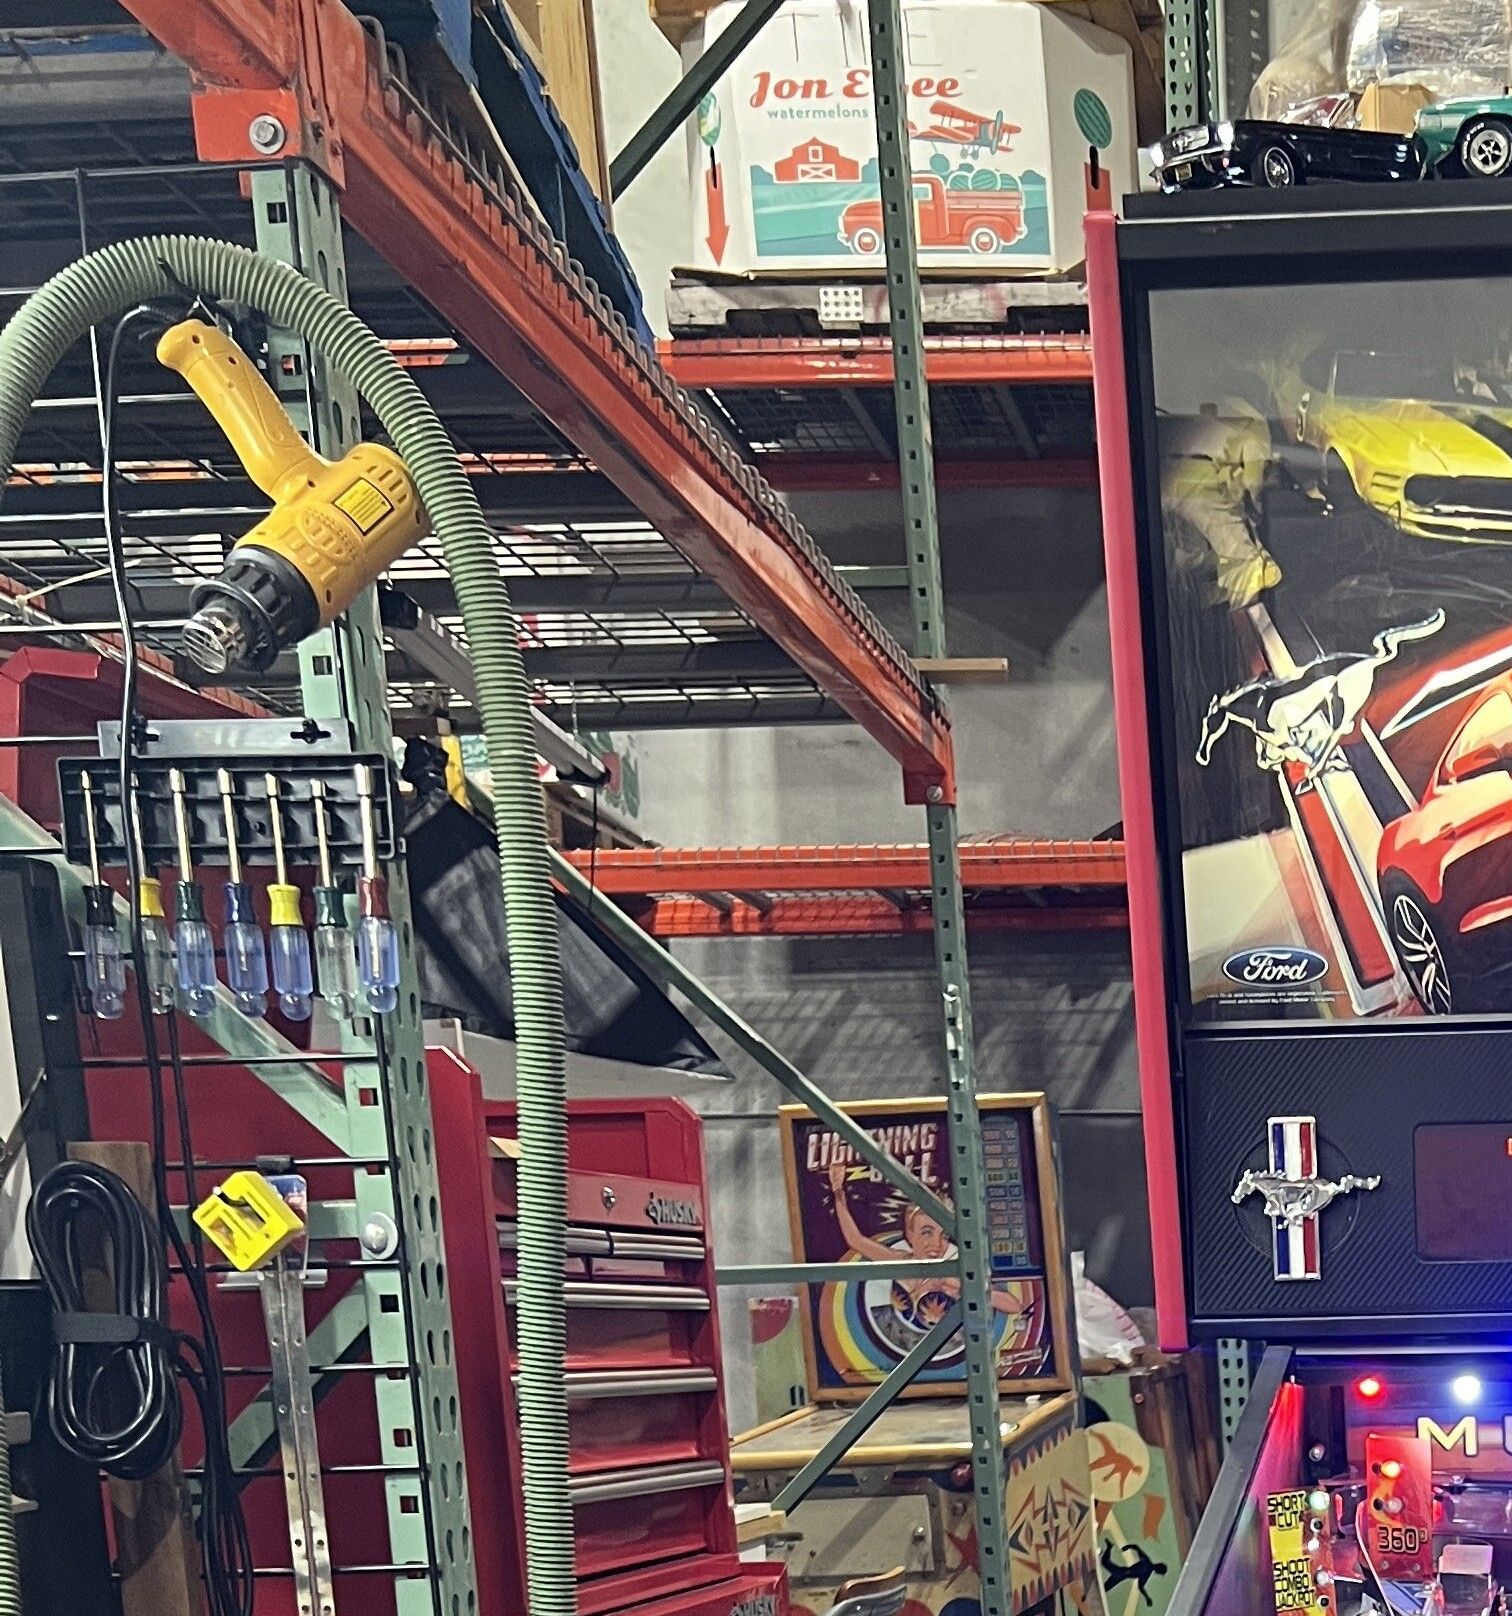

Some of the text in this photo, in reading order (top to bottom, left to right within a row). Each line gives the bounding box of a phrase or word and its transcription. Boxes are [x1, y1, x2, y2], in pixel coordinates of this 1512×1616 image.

[750, 71, 833, 107] Jon
[767, 103, 869, 119] watermelons
[1243, 952, 1309, 981] Ford
[1267, 1493, 1304, 1513] SHORT
[1277, 1511, 1299, 1528] CUT
[1273, 1558, 1310, 1578] SHOOT
[1275, 1574, 1312, 1592] COMBO
[1276, 1590, 1315, 1609] JACKPOT
